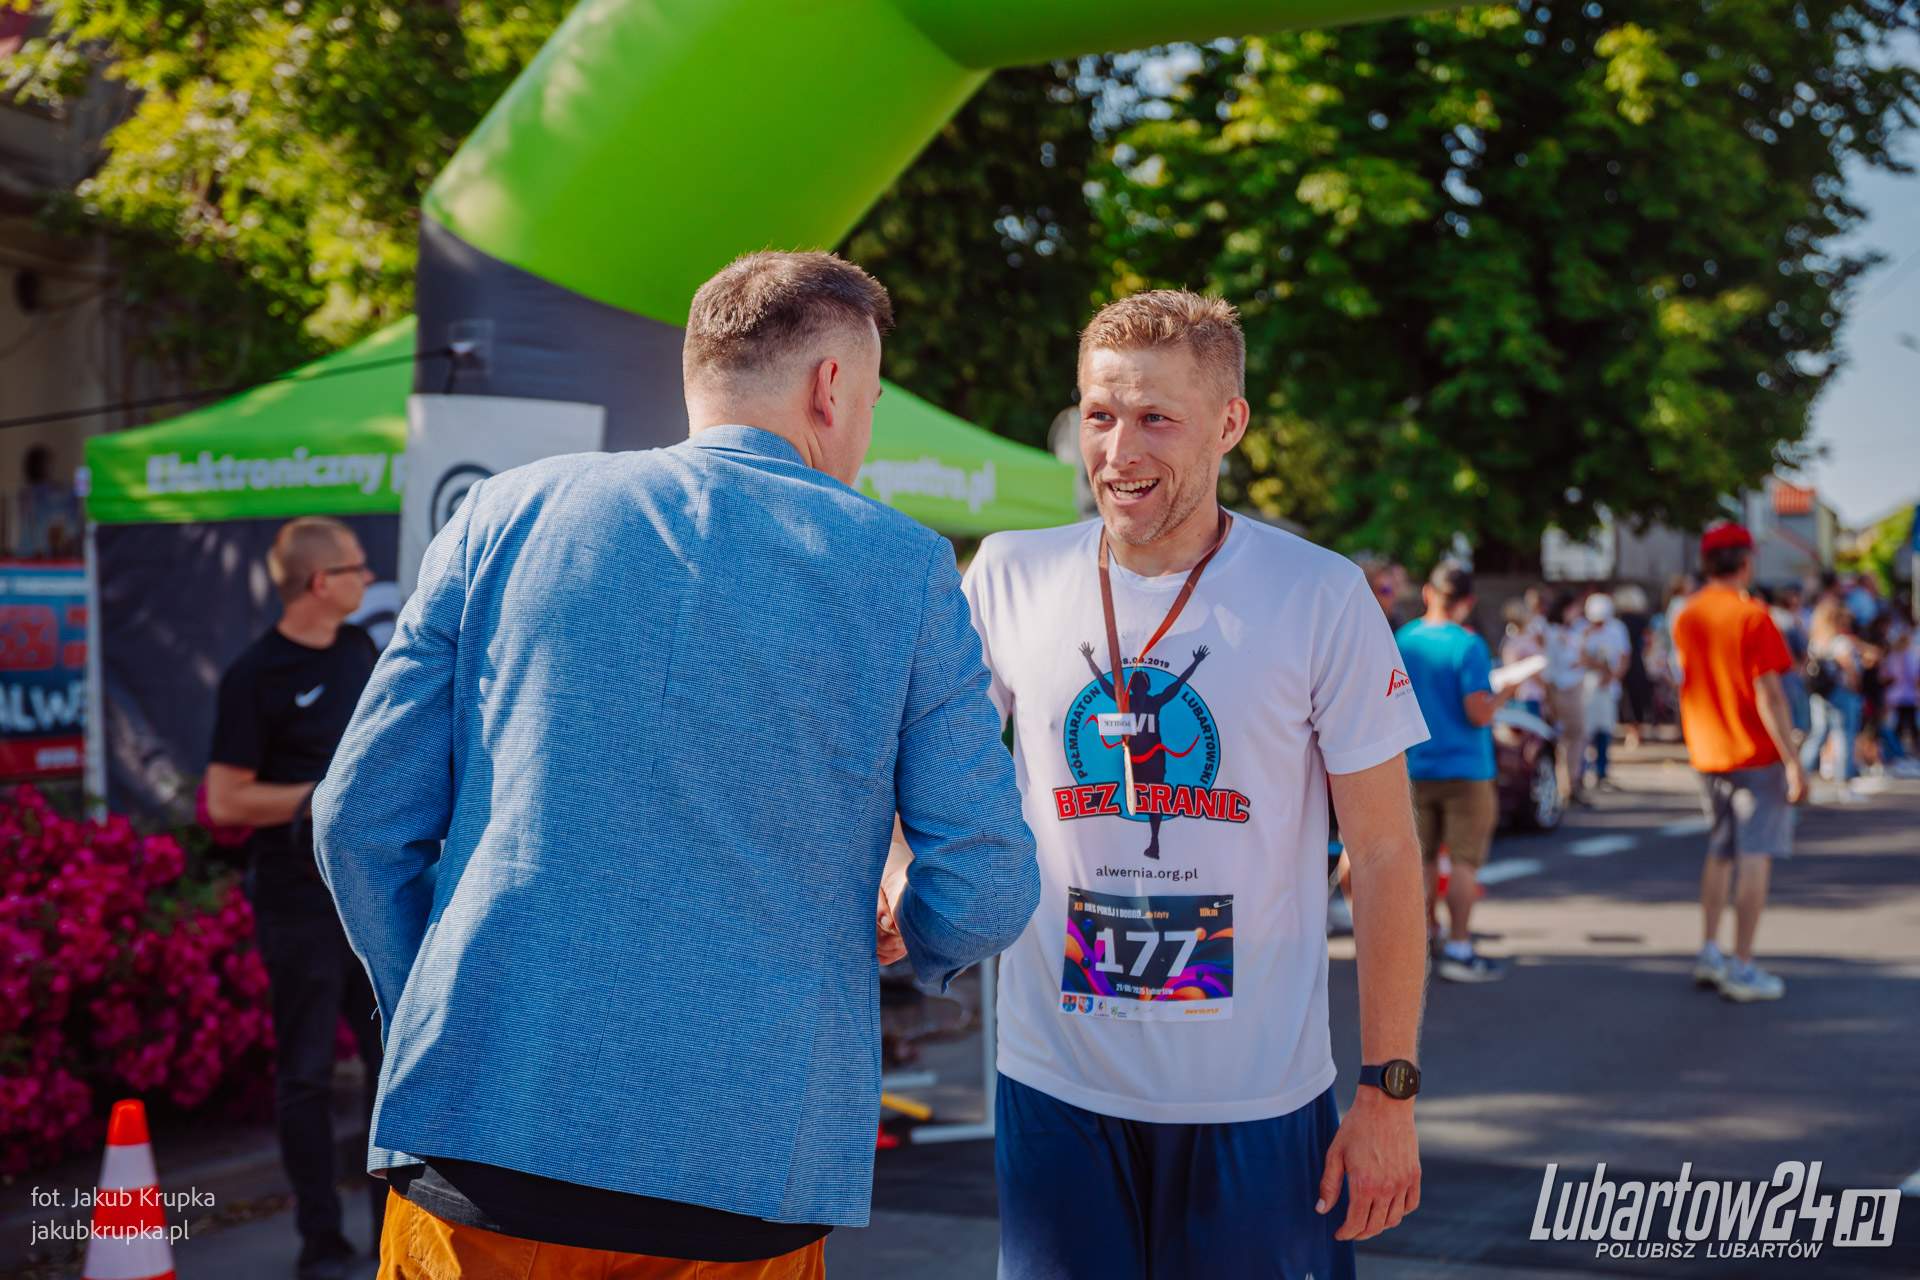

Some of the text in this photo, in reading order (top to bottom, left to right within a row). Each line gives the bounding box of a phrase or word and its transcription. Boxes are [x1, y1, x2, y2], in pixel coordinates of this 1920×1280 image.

[147, 446, 386, 495] Elektroniczny
[1069, 685, 1102, 779] PÓŁMARATON
[1181, 690, 1216, 785] LUBARTOWSKI
[1053, 782, 1250, 823] BEZ GRANIC
[1096, 866, 1198, 881] alwernia.org.pl
[1094, 927, 1199, 977] 177
